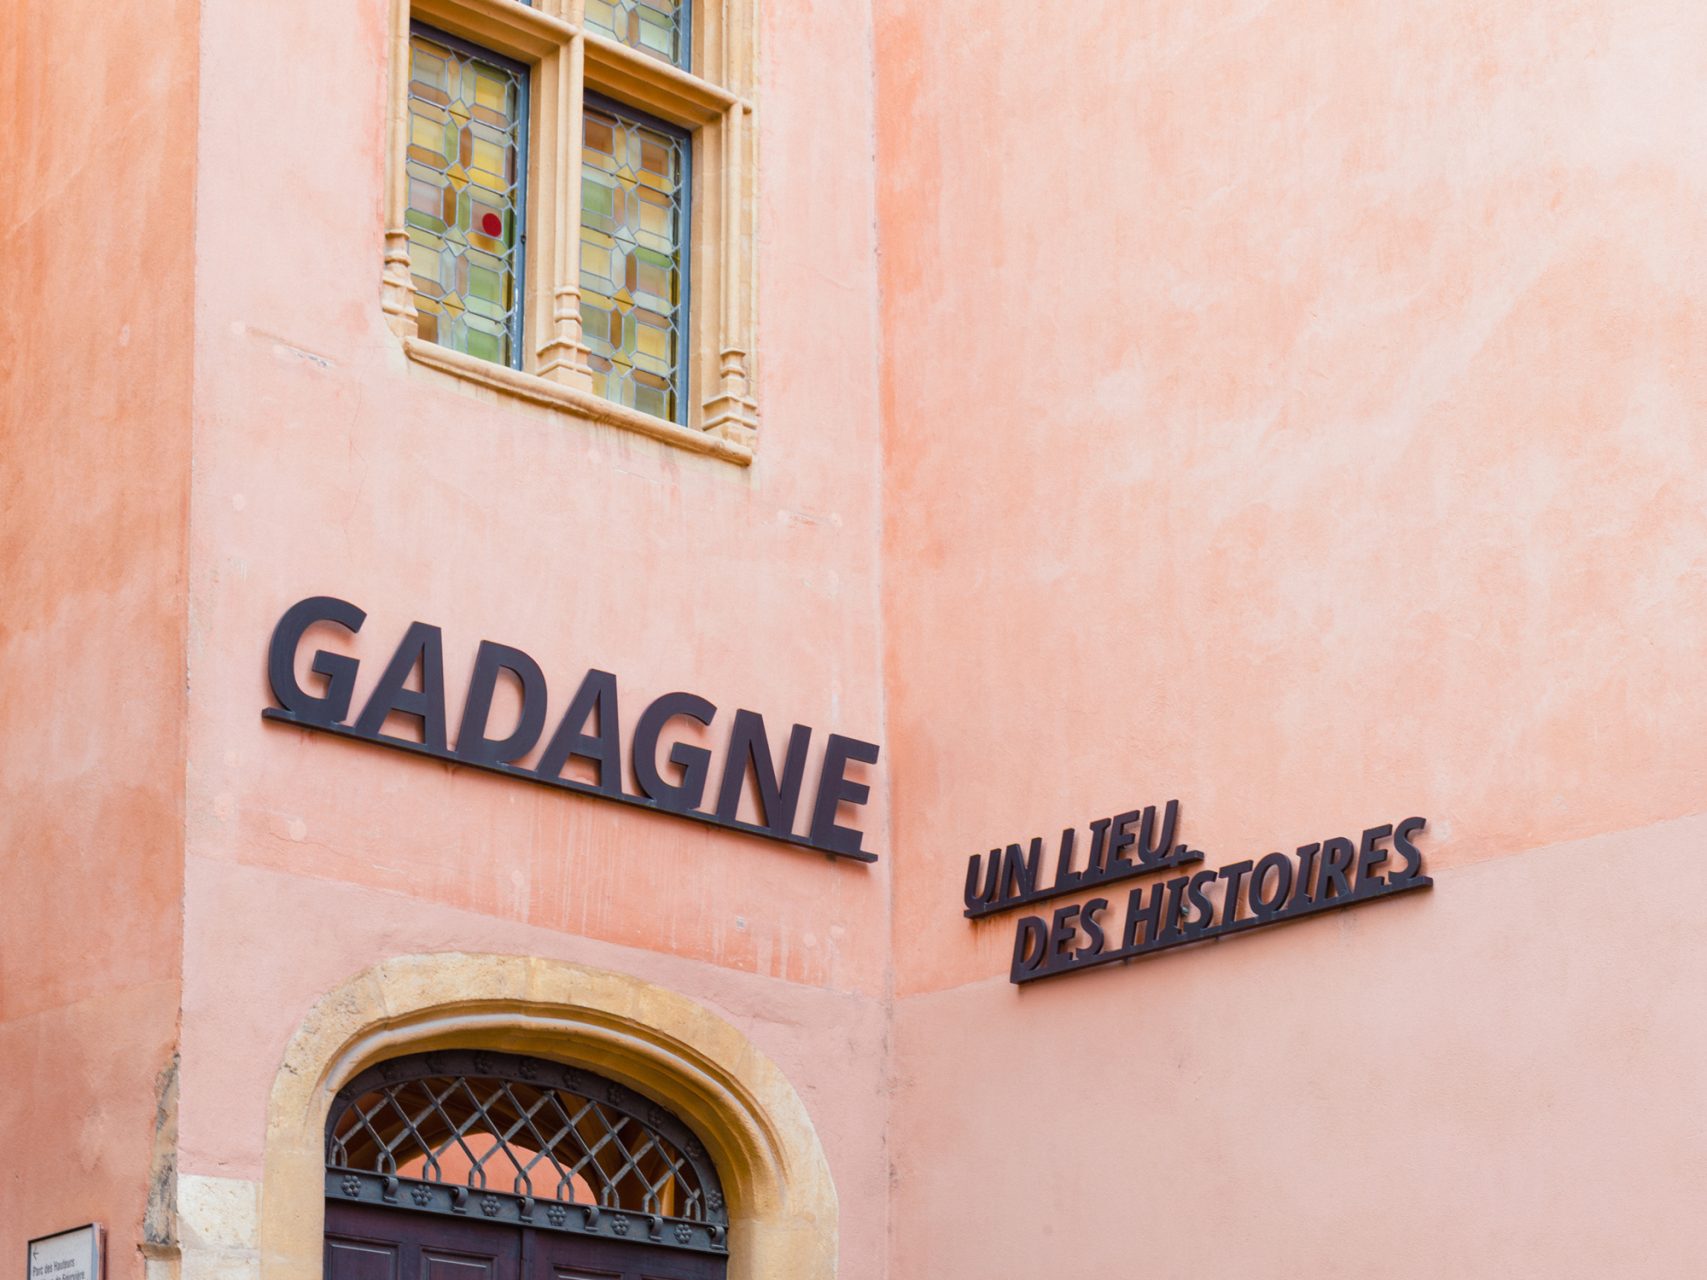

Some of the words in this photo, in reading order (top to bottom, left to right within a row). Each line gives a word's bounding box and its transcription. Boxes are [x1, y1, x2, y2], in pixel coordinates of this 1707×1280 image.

[267, 595, 880, 854] GADAGNE
[964, 837, 1042, 910] UN
[1012, 898, 1108, 978] DES
[1123, 816, 1427, 951] HISTOIRES
[32, 1266, 43, 1277] Parc
[44, 1264, 53, 1274] des
[54, 1259, 75, 1271] Hauteurs
